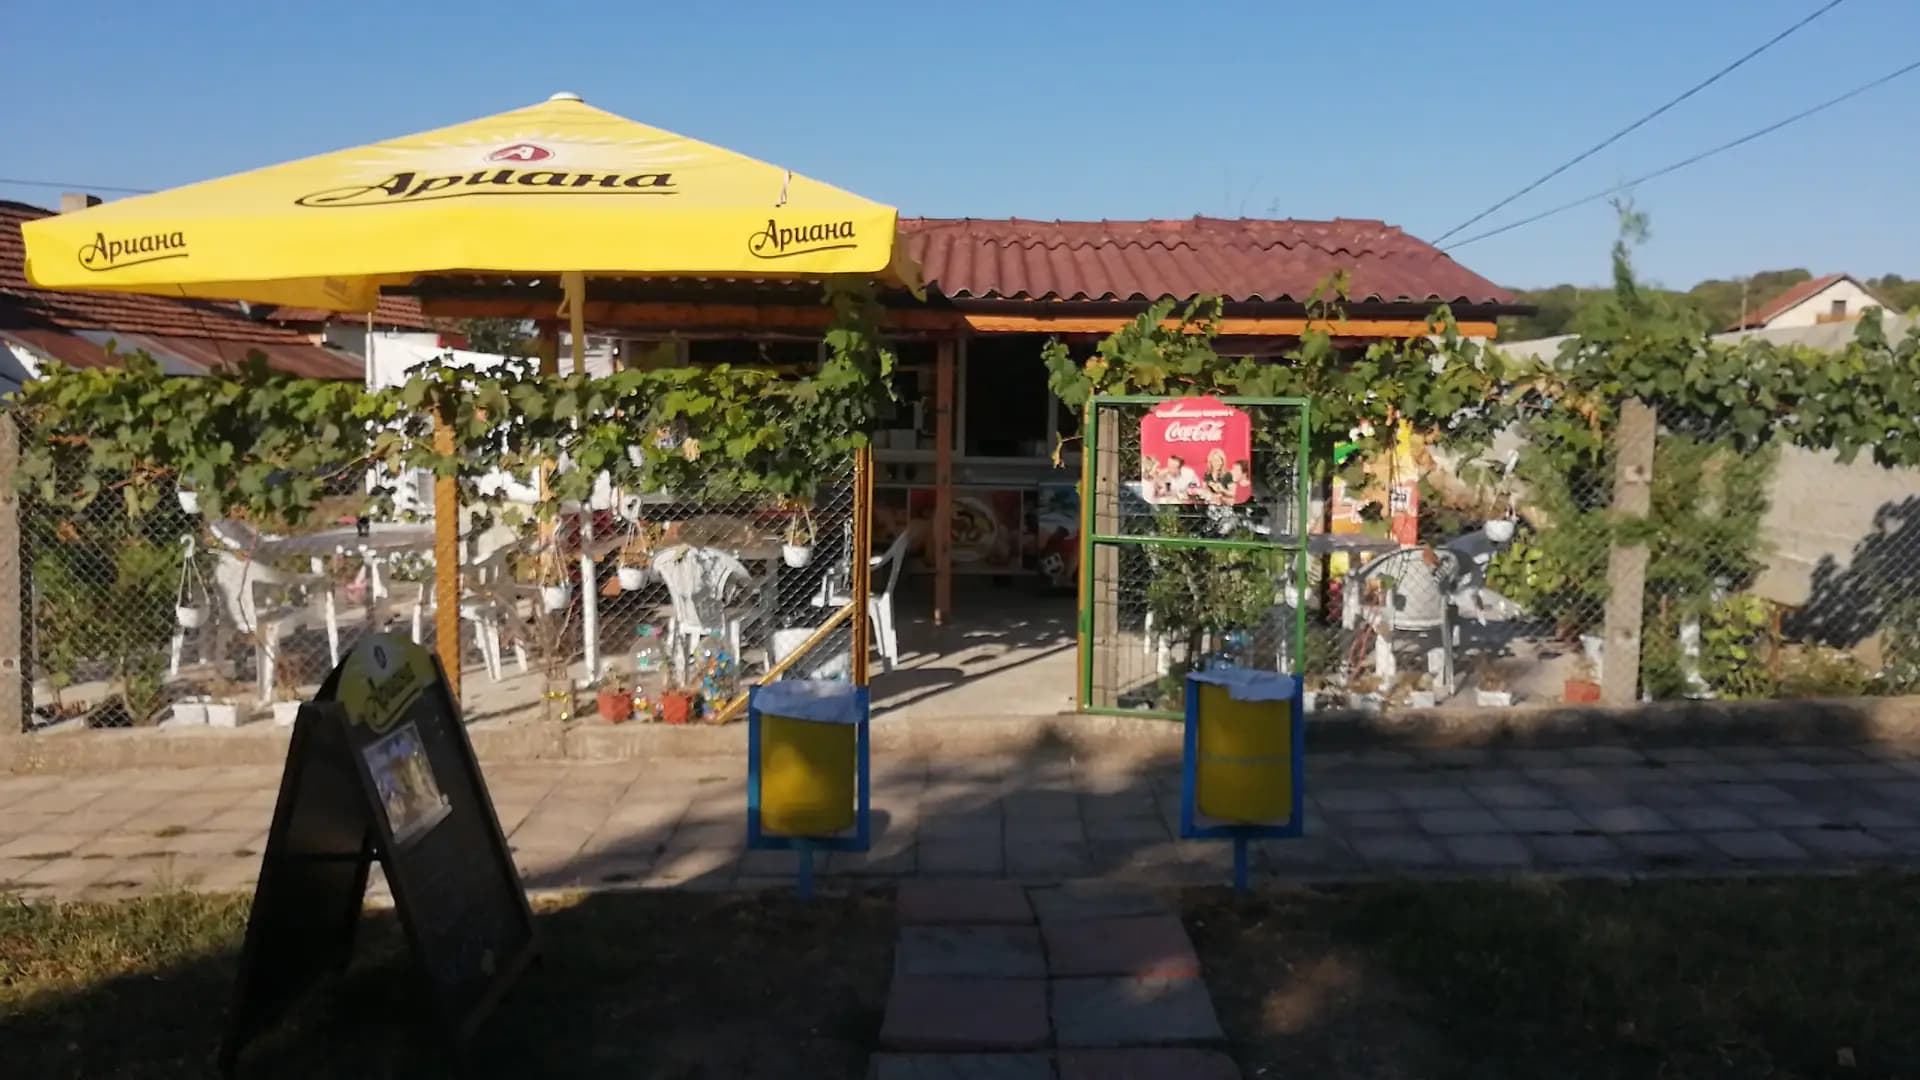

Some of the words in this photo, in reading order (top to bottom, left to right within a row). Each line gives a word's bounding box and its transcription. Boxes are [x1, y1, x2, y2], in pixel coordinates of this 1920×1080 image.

[294, 168, 680, 208] Ариана
[78, 231, 189, 272] Ариана
[747, 218, 858, 259] Ариана
